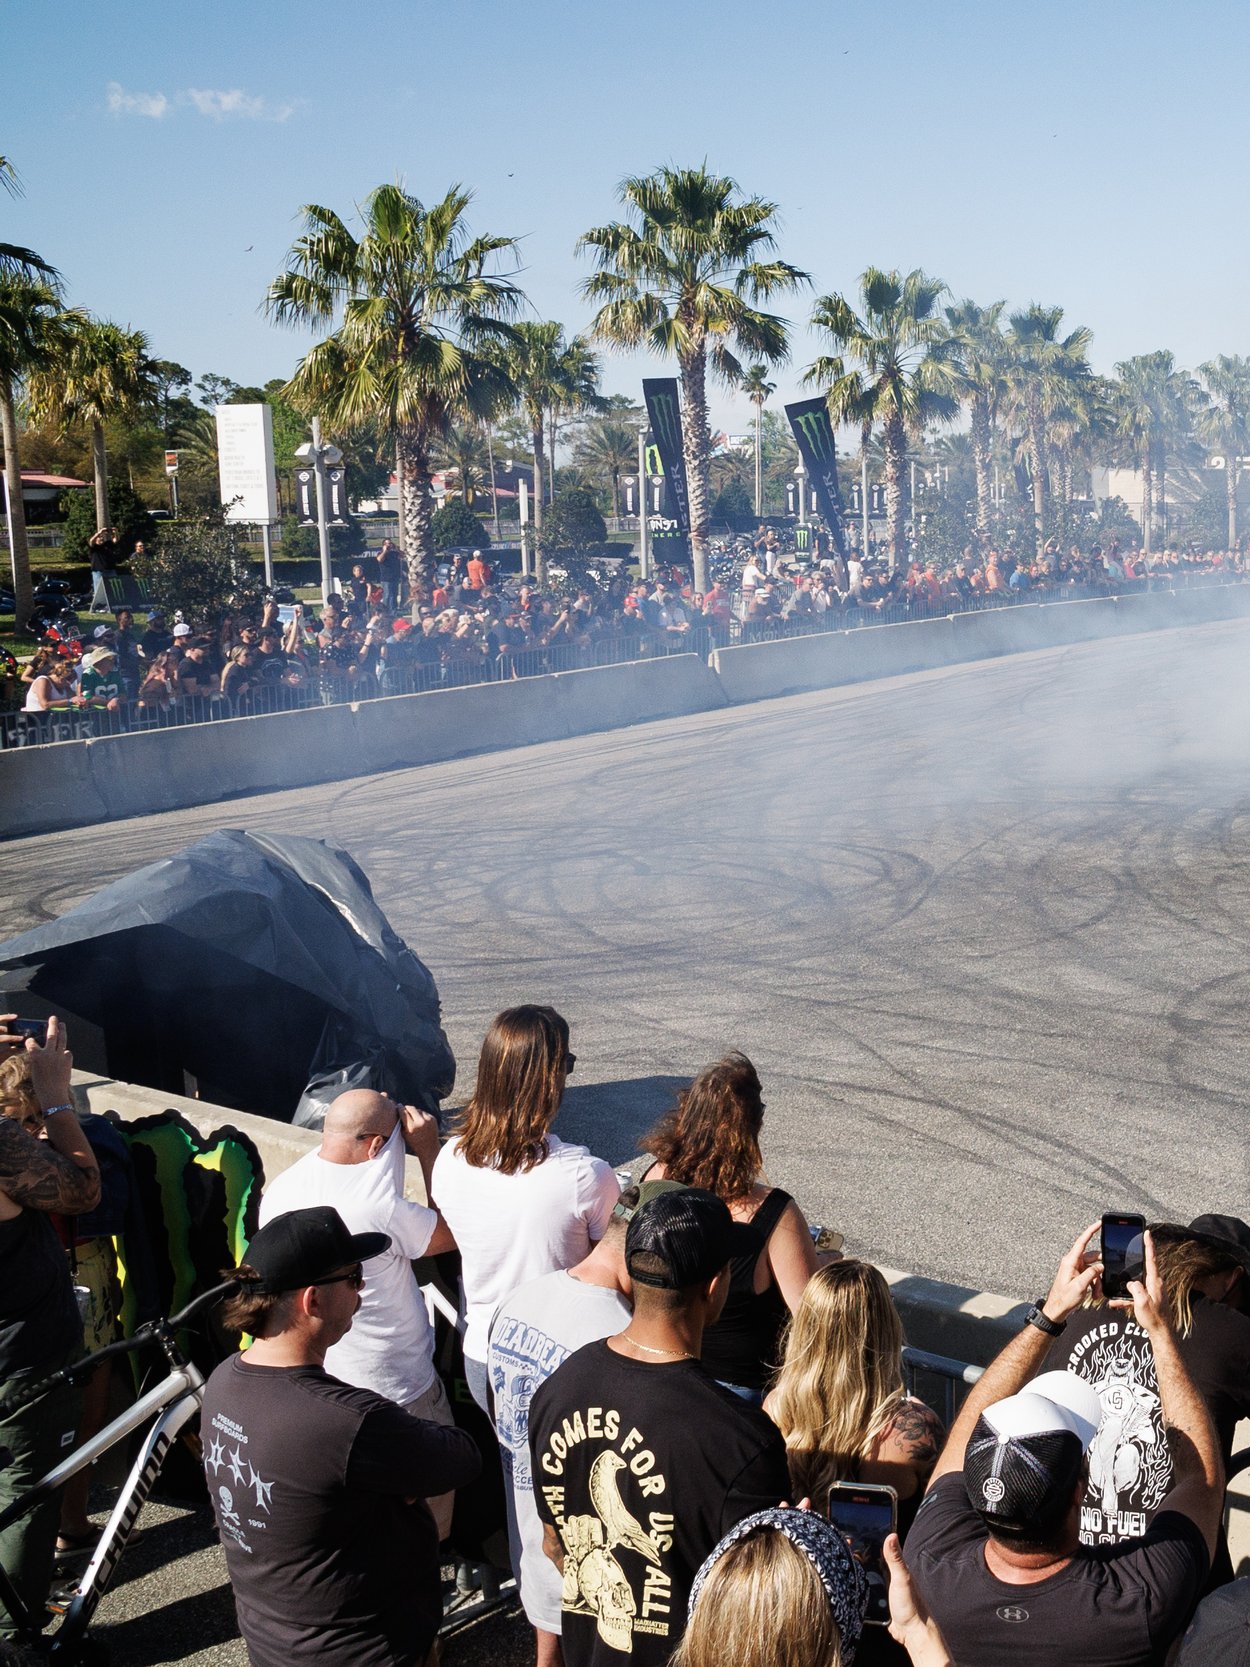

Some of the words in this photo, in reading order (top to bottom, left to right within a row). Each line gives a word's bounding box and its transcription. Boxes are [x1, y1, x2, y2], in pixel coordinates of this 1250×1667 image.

[492, 1317, 574, 1376] DEADBEA
[492, 1354, 520, 1368] CUSTOMS
[1066, 1322, 1119, 1373] CROOKED
[211, 1417, 249, 1444] SURFBOARDS
[217, 1412, 244, 1434] PREMIUM
[542, 1407, 621, 1476] COMES
[621, 1427, 666, 1498] FOR
[83, 1431, 171, 1617] SCHWINN
[248, 1518, 267, 1529] 1991
[648, 1511, 675, 1553] US
[1080, 1505, 1103, 1533] NO
[641, 1565, 672, 1618] ALL
